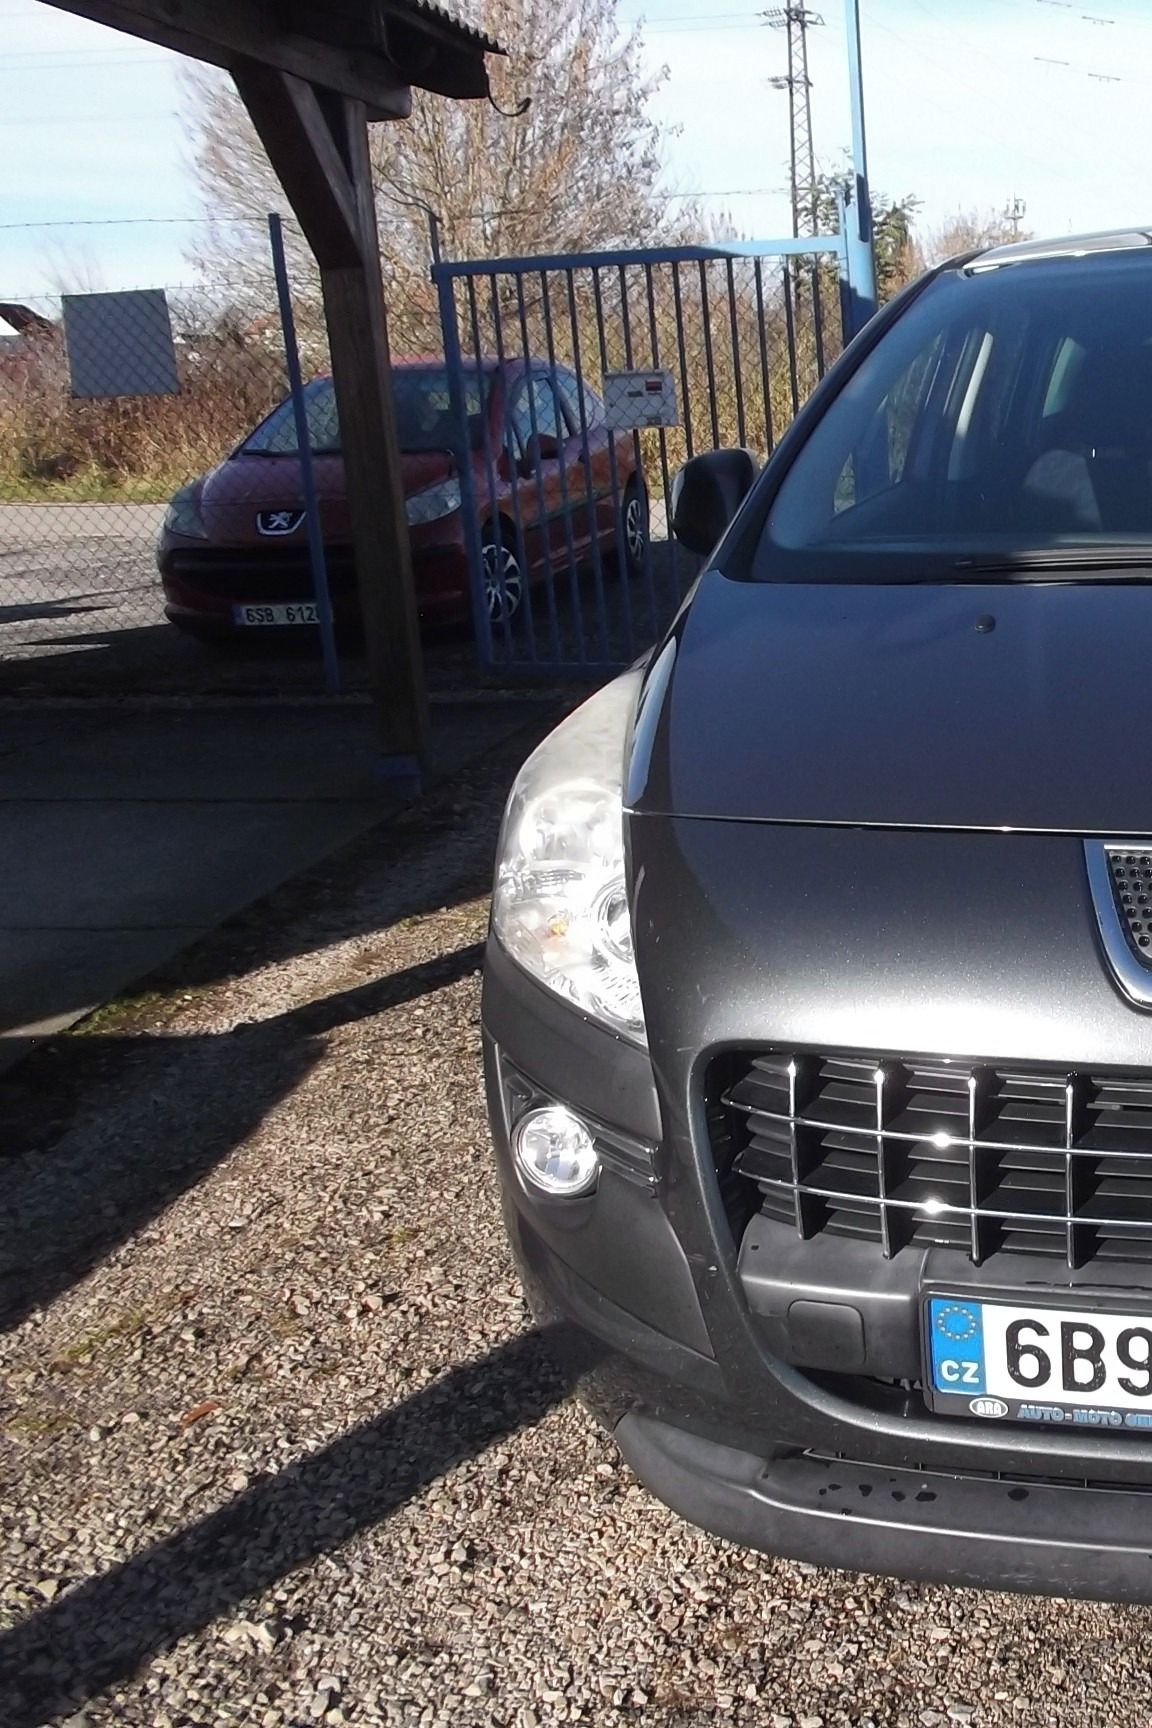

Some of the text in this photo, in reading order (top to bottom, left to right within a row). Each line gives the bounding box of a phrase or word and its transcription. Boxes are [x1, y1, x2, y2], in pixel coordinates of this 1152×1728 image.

[246, 607, 274, 623] 6SB
[941, 1360, 980, 1384] CZ
[976, 1401, 1002, 1416] ARA
